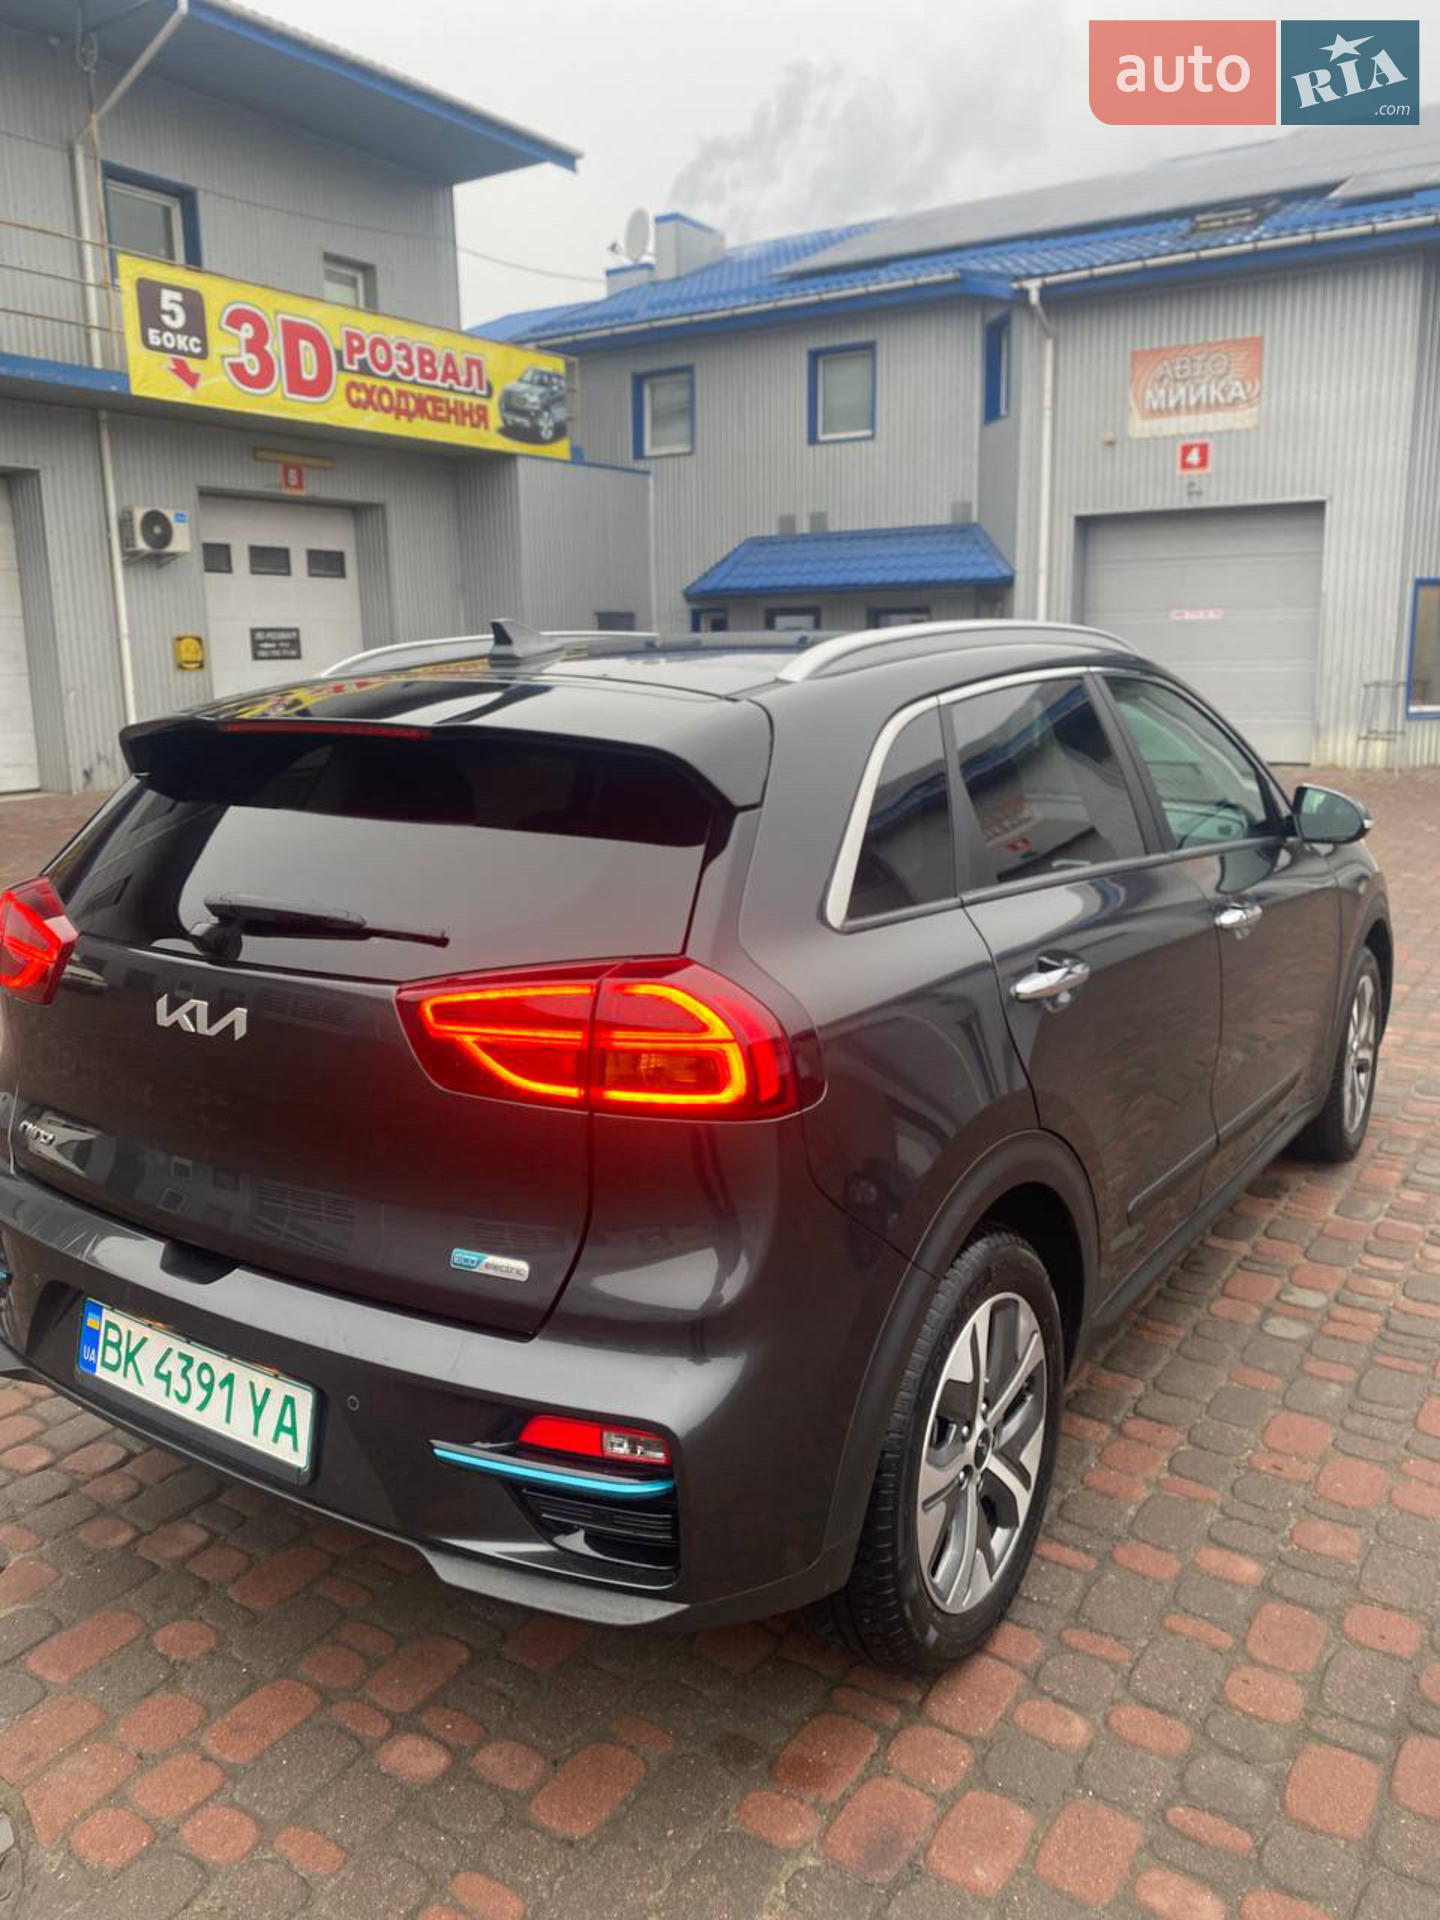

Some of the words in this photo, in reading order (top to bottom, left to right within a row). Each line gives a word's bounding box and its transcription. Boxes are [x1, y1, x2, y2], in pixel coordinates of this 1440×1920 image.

[160, 288, 187, 330] 5
[147, 327, 203, 355] БОКС
[219, 301, 338, 404] 3D
[342, 325, 490, 397] РОЗВАЛ
[345, 380, 490, 431] СХОДЖЕННЯ
[1184, 447, 1202, 466] 4
[156, 993, 248, 1041] KIA
[83, 1344, 97, 1364] UA
[100, 1319, 148, 1386] BK
[153, 1347, 235, 1425] 4391
[249, 1380, 299, 1453] YA
